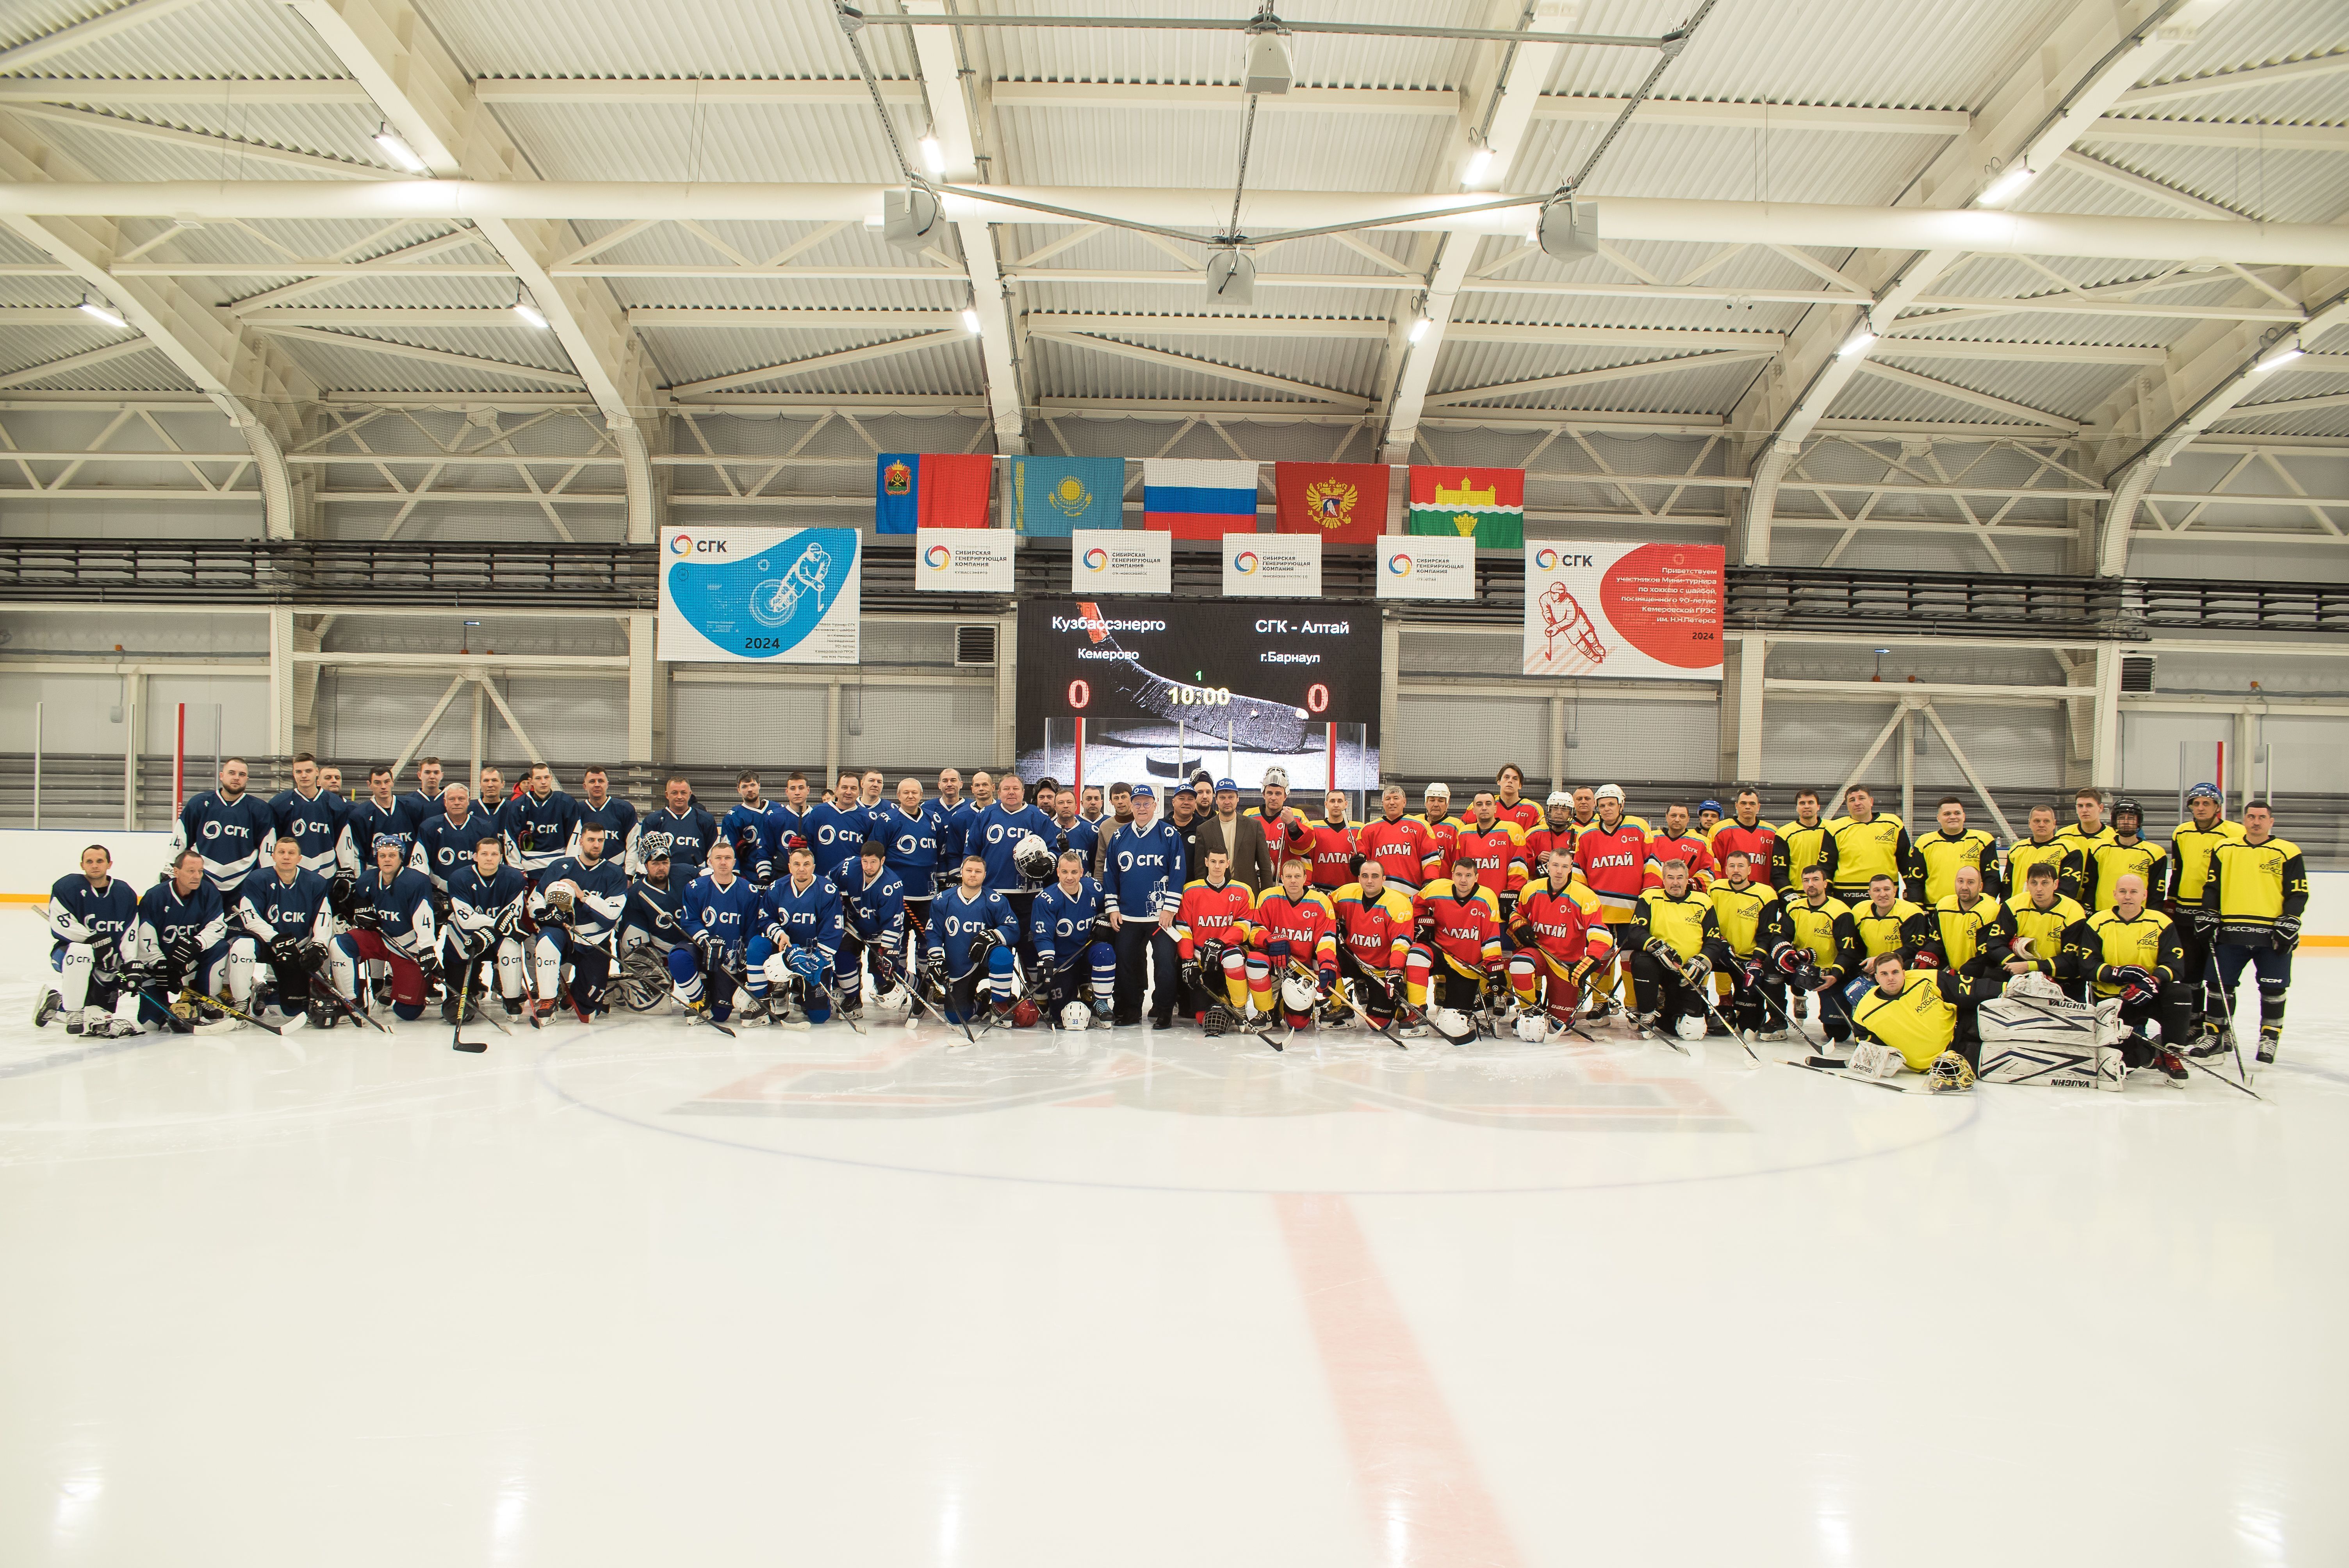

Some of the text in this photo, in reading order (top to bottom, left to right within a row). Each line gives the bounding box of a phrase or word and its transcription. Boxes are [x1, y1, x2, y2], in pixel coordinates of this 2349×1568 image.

[697, 540, 727, 553] СГК
[1563, 555, 1593, 567] СГК
[1642, 606, 1694, 614] Кемеровской
[1052, 616, 1166, 633] Кузбассэнерго
[1256, 619, 1287, 634] СГК
[1302, 620, 1349, 634] Алтай
[745, 638, 780, 649] 2024
[1078, 648, 1139, 662] Кемерово
[1260, 650, 1320, 664] г.Барнаул
[1196, 671, 1201, 681] 1
[1068, 680, 1089, 708] 0
[1168, 687, 1230, 705] 10:00
[1308, 684, 1329, 712] 0
[224, 825, 250, 839] СГК
[537, 823, 559, 834] СГК
[605, 830, 619, 840] ГК
[398, 832, 413, 842] ГК
[676, 836, 700, 848] СГК
[1375, 842, 1411, 858] АЛТАЙ
[1136, 854, 1164, 866] СГК
[1591, 851, 1634, 869] АЛТАЙ
[1772, 855, 1787, 867] 51
[1041, 891, 1054, 904] СГК
[1197, 912, 1233, 927] АЛТАЙ
[95, 921, 125, 932] СГК
[979, 930, 994, 942] CM
[1349, 933, 1381, 948] ЛТАЙ
[1841, 937, 1855, 949] 71
[419, 953, 436, 962] BAU
[587, 985, 606, 1002] 17
[1051, 987, 1062, 1000] 33
[2047, 1000, 2087, 1010] VAUGHN
[1242, 1019, 1259, 1034] CCM
[2051, 1079, 2091, 1089] VAUGHN
